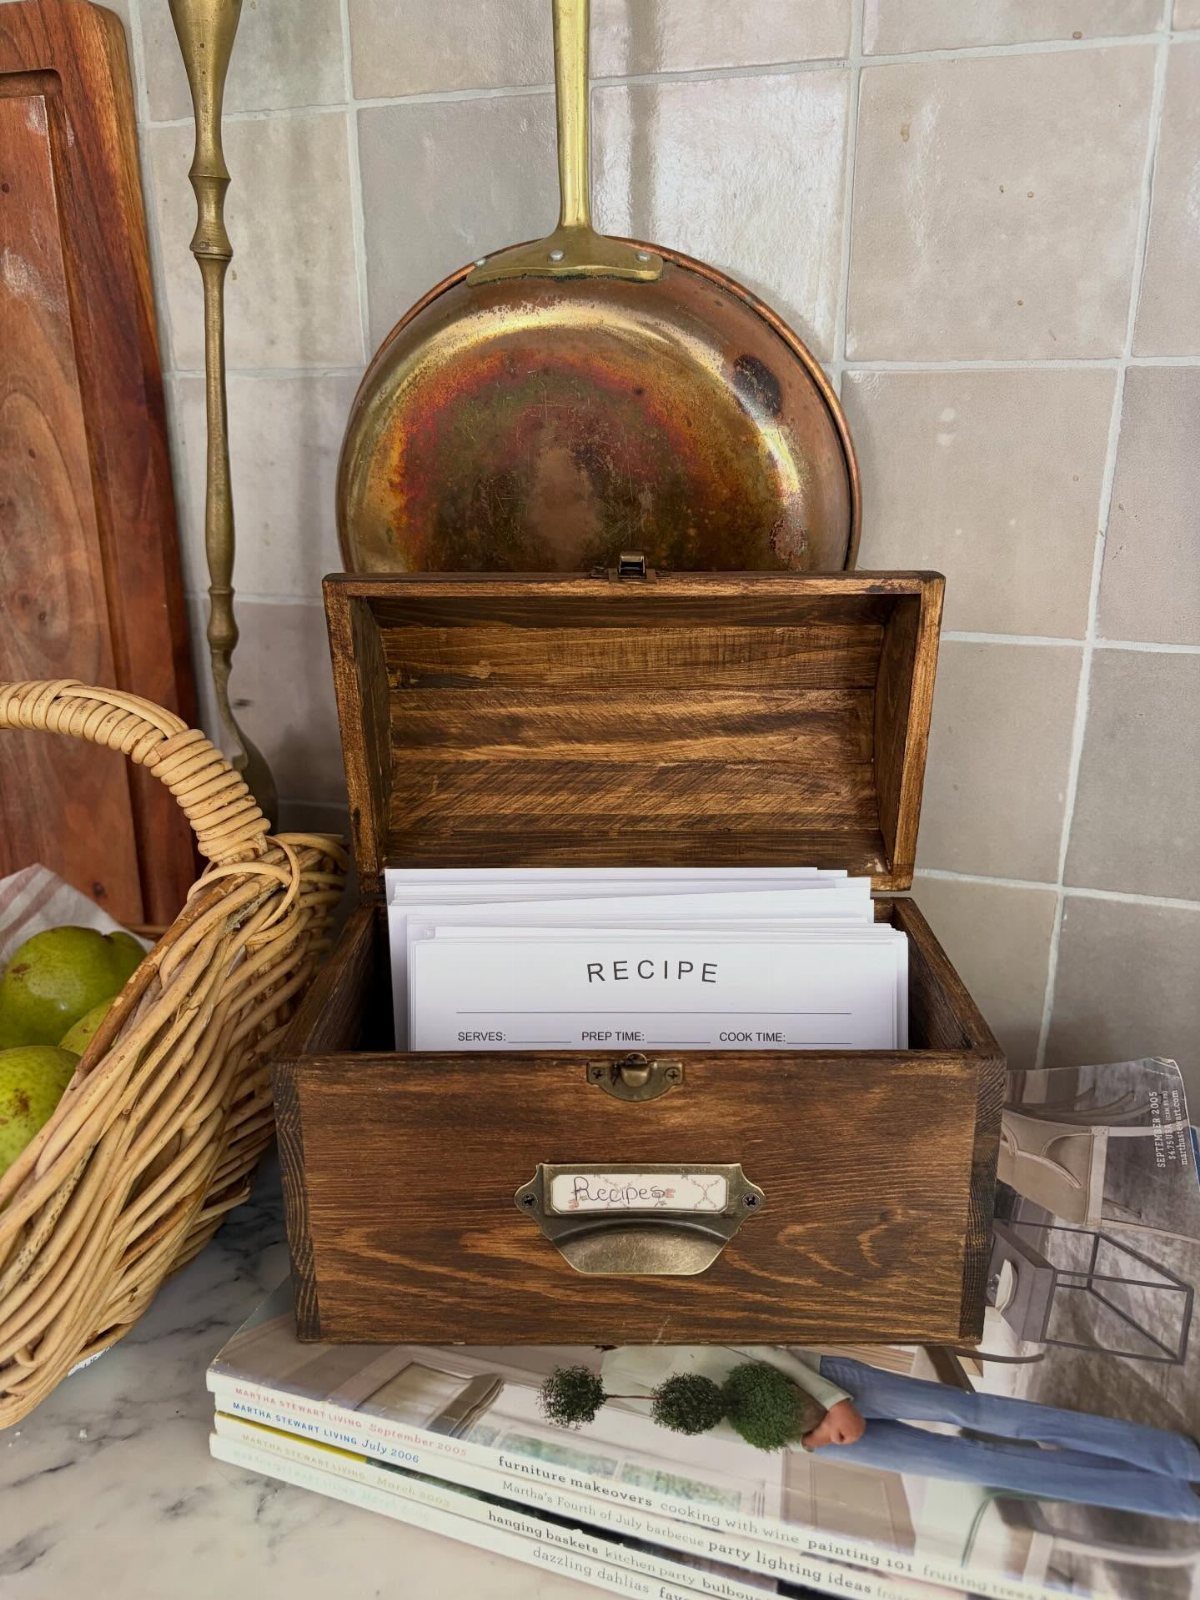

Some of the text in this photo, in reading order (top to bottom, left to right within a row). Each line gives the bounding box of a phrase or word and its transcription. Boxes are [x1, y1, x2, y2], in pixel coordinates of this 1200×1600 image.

[587, 960, 719, 983] RECIPE
[457, 1031, 507, 1042] SERVES:
[581, 1031, 645, 1042] PREP TIME:
[719, 1032, 786, 1042] COOK TIME:
[1149, 1091, 1166, 1168] SEPTEMBER 2005
[572, 1176, 666, 1204] Recipes
[232, 1402, 420, 1464] MARTHA STEWART LIVING July 2006
[235, 1387, 468, 1458] MARTHA STEWART LIVING September 2005
[498, 1456, 566, 1483] furniture
[570, 1477, 653, 1507] makeovers
[660, 1502, 721, 1527] cooking
[725, 1520, 759, 1534] with
[762, 1528, 800, 1544] wine
[807, 1540, 881, 1566] painting
[502, 1480, 553, 1504] Martha's
[557, 1496, 597, 1517] Fourth
[599, 1509, 613, 1520] of
[616, 1514, 642, 1531] July
[646, 1522, 705, 1546] barbecue
[708, 1541, 751, 1561] party
[756, 1550, 822, 1582] lighting
[827, 1571, 872, 1594] ideas
[488, 1510, 543, 1539] hanging
[545, 1528, 599, 1554] baskets
[604, 1547, 656, 1572] kitchen
[659, 1567, 696, 1586] party
[533, 1547, 593, 1577] dazzling
[597, 1566, 650, 1593] dahlias
